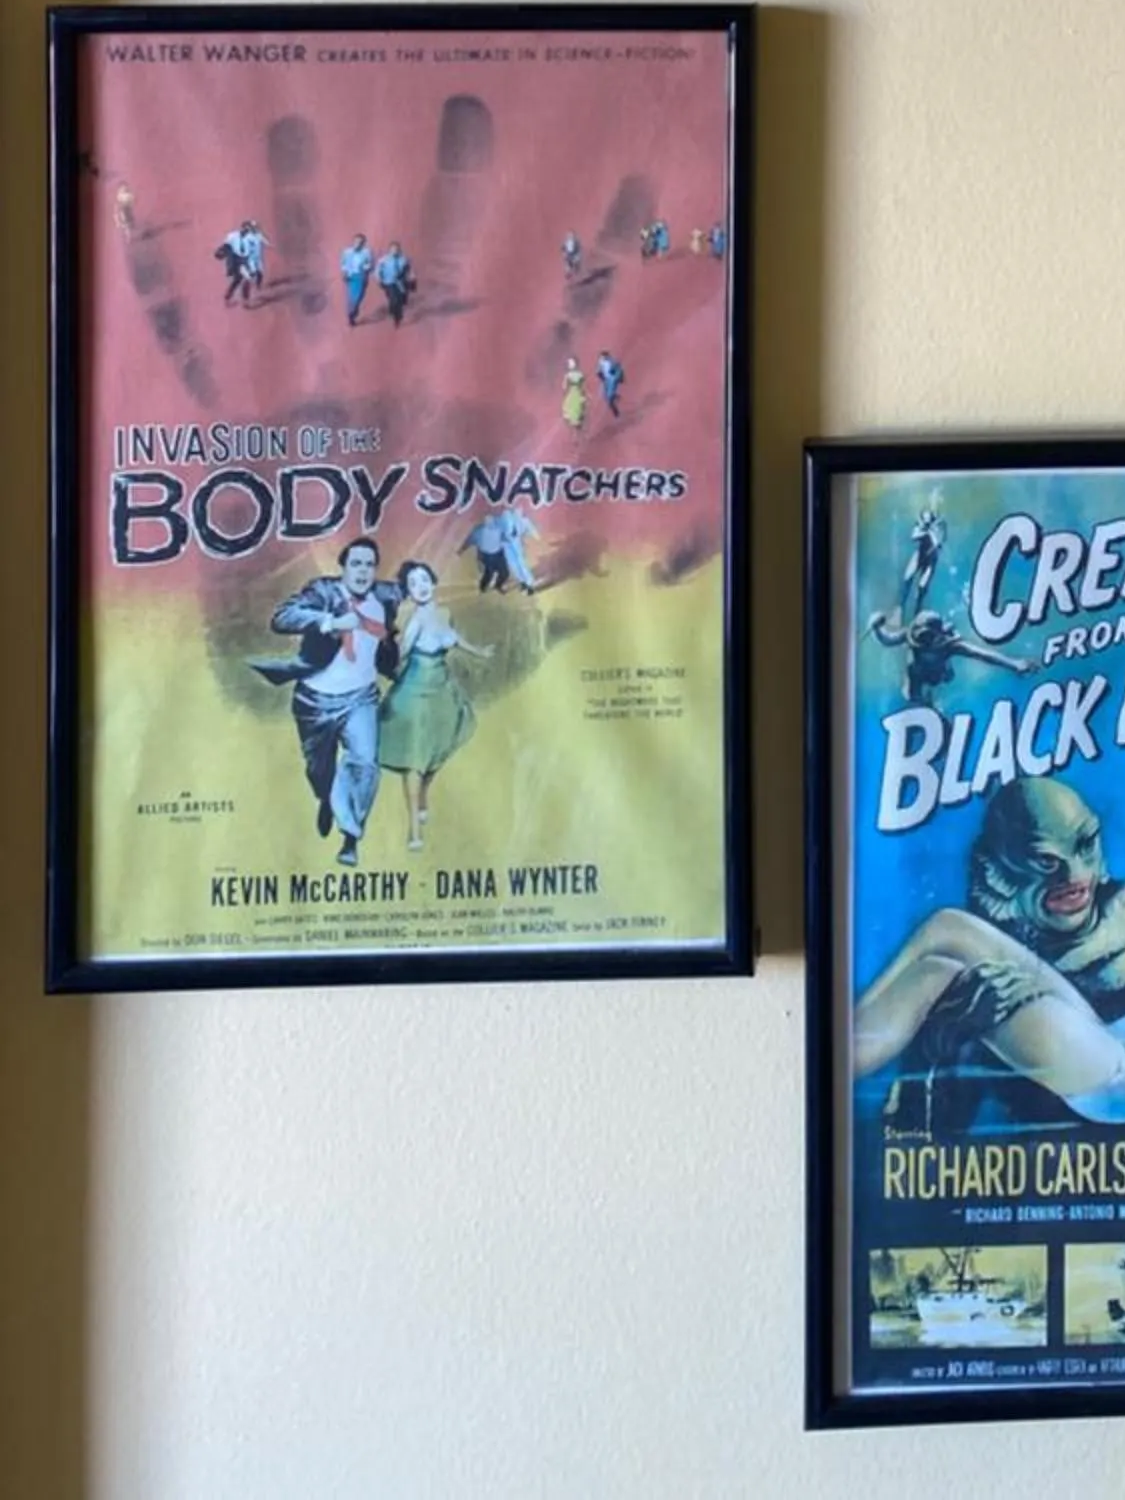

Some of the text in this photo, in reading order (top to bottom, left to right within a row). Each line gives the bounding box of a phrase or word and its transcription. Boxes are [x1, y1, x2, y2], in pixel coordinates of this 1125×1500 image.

[105, 43, 194, 63] WALTER
[203, 43, 307, 63] WANGER
[317, 48, 386, 62] CREATES
[396, 48, 424, 62] THE
[114, 422, 381, 468] INVASION OF THE
[111, 453, 690, 567] BODY SNATCHERS
[877, 674, 1108, 833] BLACK
[137, 800, 235, 815] ALLIED ARTISTS
[211, 864, 599, 906] KEVIN McCARTHY DANA WYNTER
[883, 1143, 1027, 1200] RICHARD
